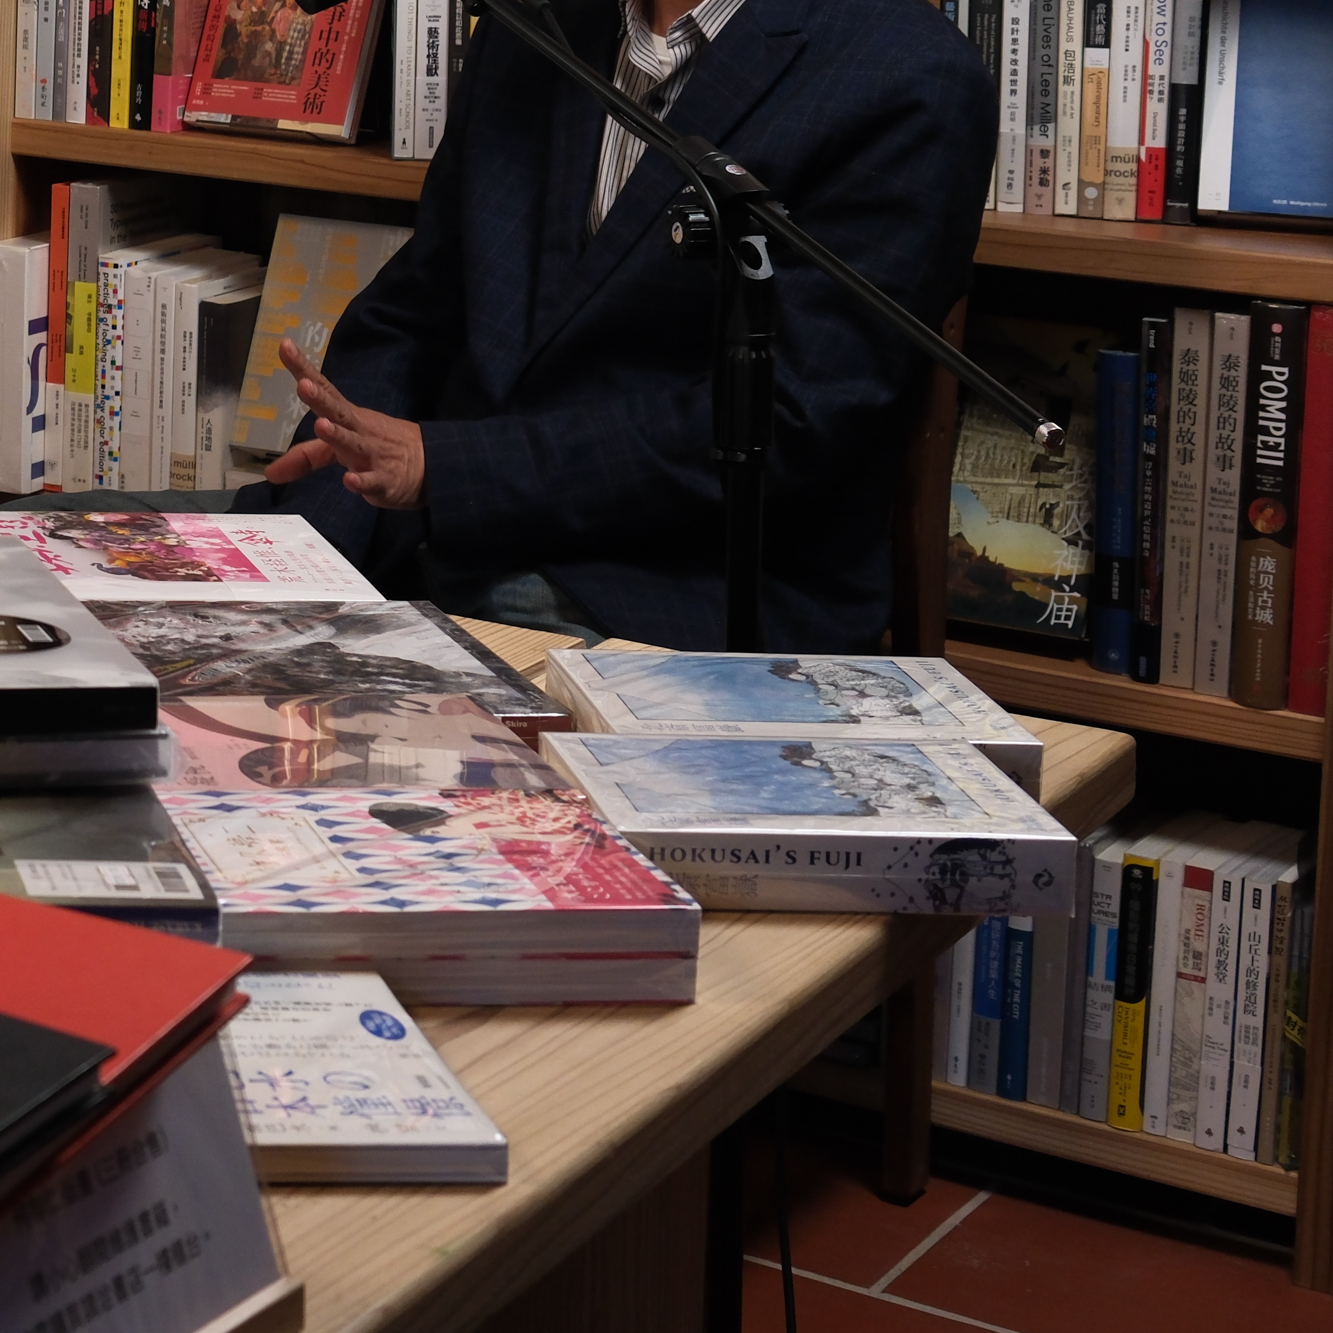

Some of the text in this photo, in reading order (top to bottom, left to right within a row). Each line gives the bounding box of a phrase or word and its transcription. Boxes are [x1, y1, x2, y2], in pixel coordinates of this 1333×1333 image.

[1041, 17, 1055, 51] Lives
[1065, 0, 1075, 43] BAUHAUS
[1156, 20, 1168, 31] to
[425, 26, 440, 77] 藝術怪獸
[1008, 17, 1021, 97] 設計思考改造世界
[1041, 55, 1054, 70] of
[1062, 49, 1077, 86] 包浩斯
[1154, 32, 1166, 66] See
[1040, 72, 1053, 98] Lee
[1092, 70, 1106, 129] Contemporary
[1039, 102, 1053, 139] Miller
[102, 272, 110, 315] practices
[101, 327, 109, 363] looking
[1175, 348, 1200, 465] 泰姬陵的故事
[1214, 353, 1241, 472] 泰姬陵的故事
[1255, 364, 1289, 467] POMPEII
[1170, 480, 1197, 490] Mahal
[1209, 486, 1236, 496] Mahal
[1254, 555, 1277, 625] 庞贝古城
[505, 720, 528, 728] Skira
[649, 845, 864, 870] HOKUSAI'S FUJI
[1092, 901, 1110, 909] UCT
[1094, 893, 1113, 901] STR
[1193, 903, 1206, 941] ROME
[1215, 922, 1231, 985] 公東的教堂
[1243, 930, 1262, 1017] 山丘上的修道院
